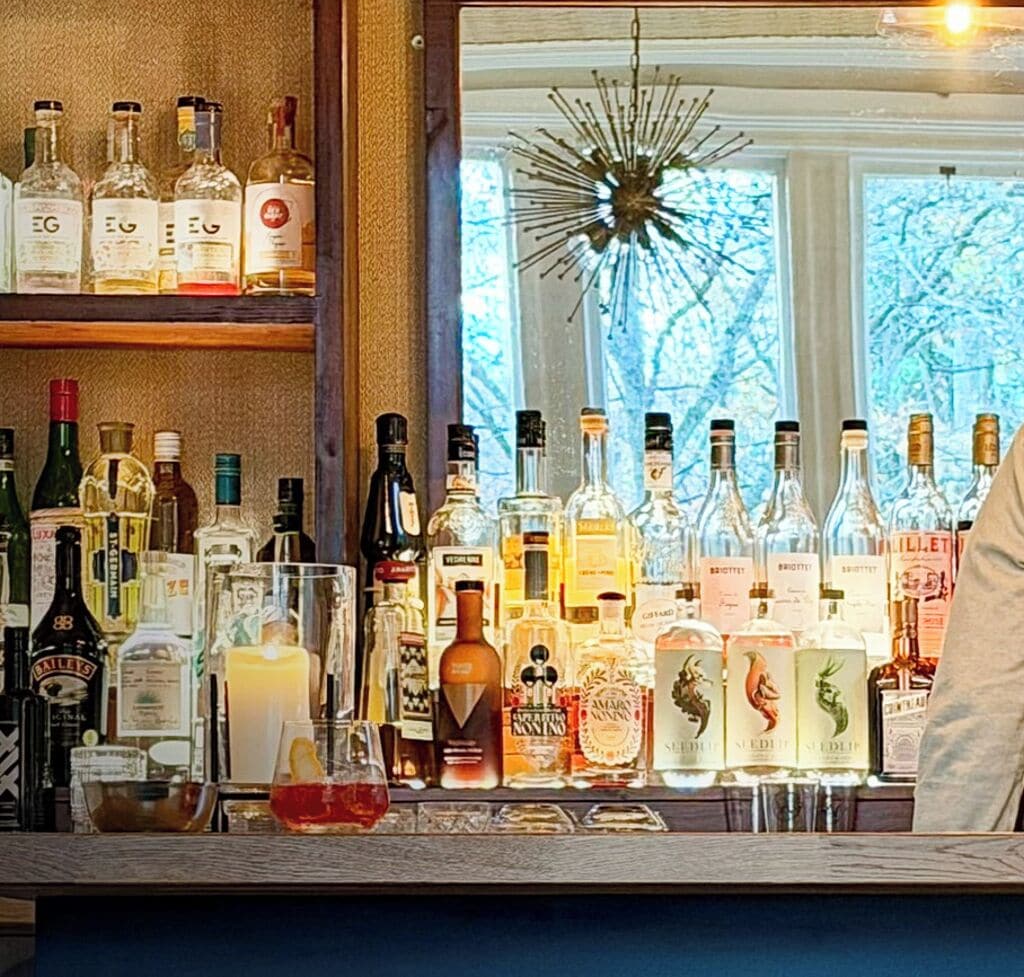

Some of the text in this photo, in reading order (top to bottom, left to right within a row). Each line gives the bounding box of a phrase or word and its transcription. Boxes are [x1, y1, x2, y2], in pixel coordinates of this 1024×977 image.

[32, 215, 60, 233] EG
[105, 216, 138, 234] EG
[188, 216, 221, 234] EG
[898, 536, 951, 553] ILLET
[34, 655, 92, 675] BAILEYS
[512, 722, 567, 736] NONINO
